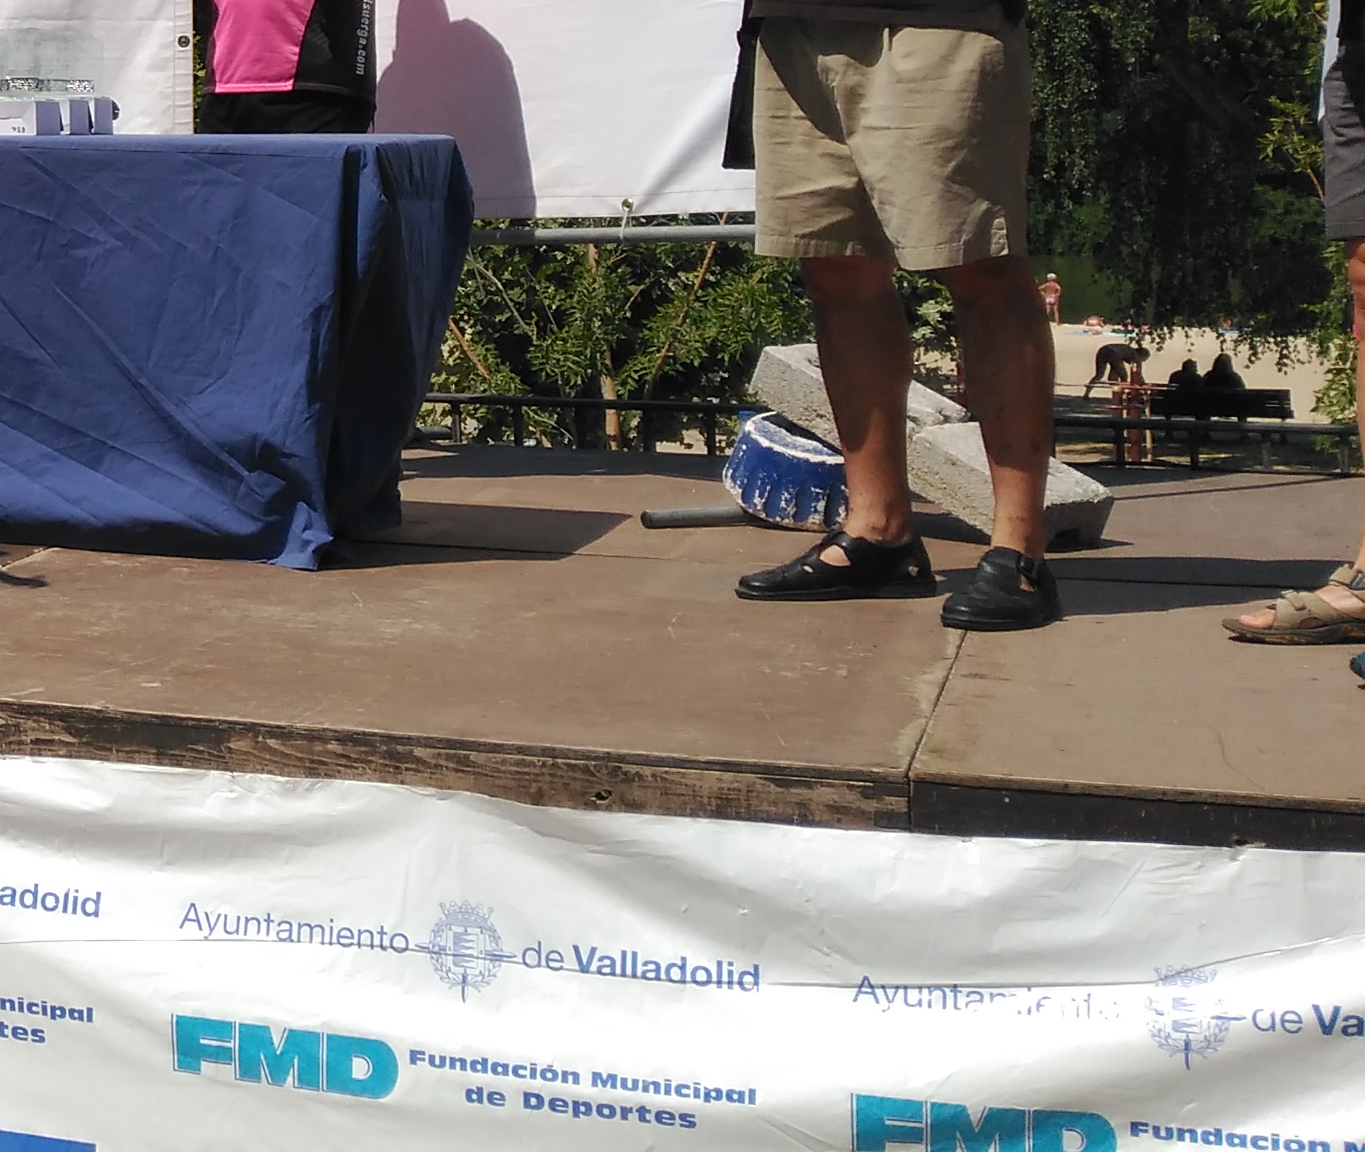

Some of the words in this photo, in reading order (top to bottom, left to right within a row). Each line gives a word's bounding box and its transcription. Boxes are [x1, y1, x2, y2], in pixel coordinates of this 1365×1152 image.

[179, 902, 411, 954] Ayuntamiento
[521, 941, 565, 972] de
[573, 944, 761, 992] Valladolid
[854, 975, 1120, 1020] Ayuntaiet
[171, 1012, 399, 1100] FMD
[409, 1049, 580, 1086] Fundación
[591, 1070, 757, 1107] Municipal
[465, 1086, 506, 1108] de
[523, 1090, 697, 1130] Deportes
[851, 1093, 1117, 1152] FMD
[1129, 1121, 1331, 1152] Fundación
